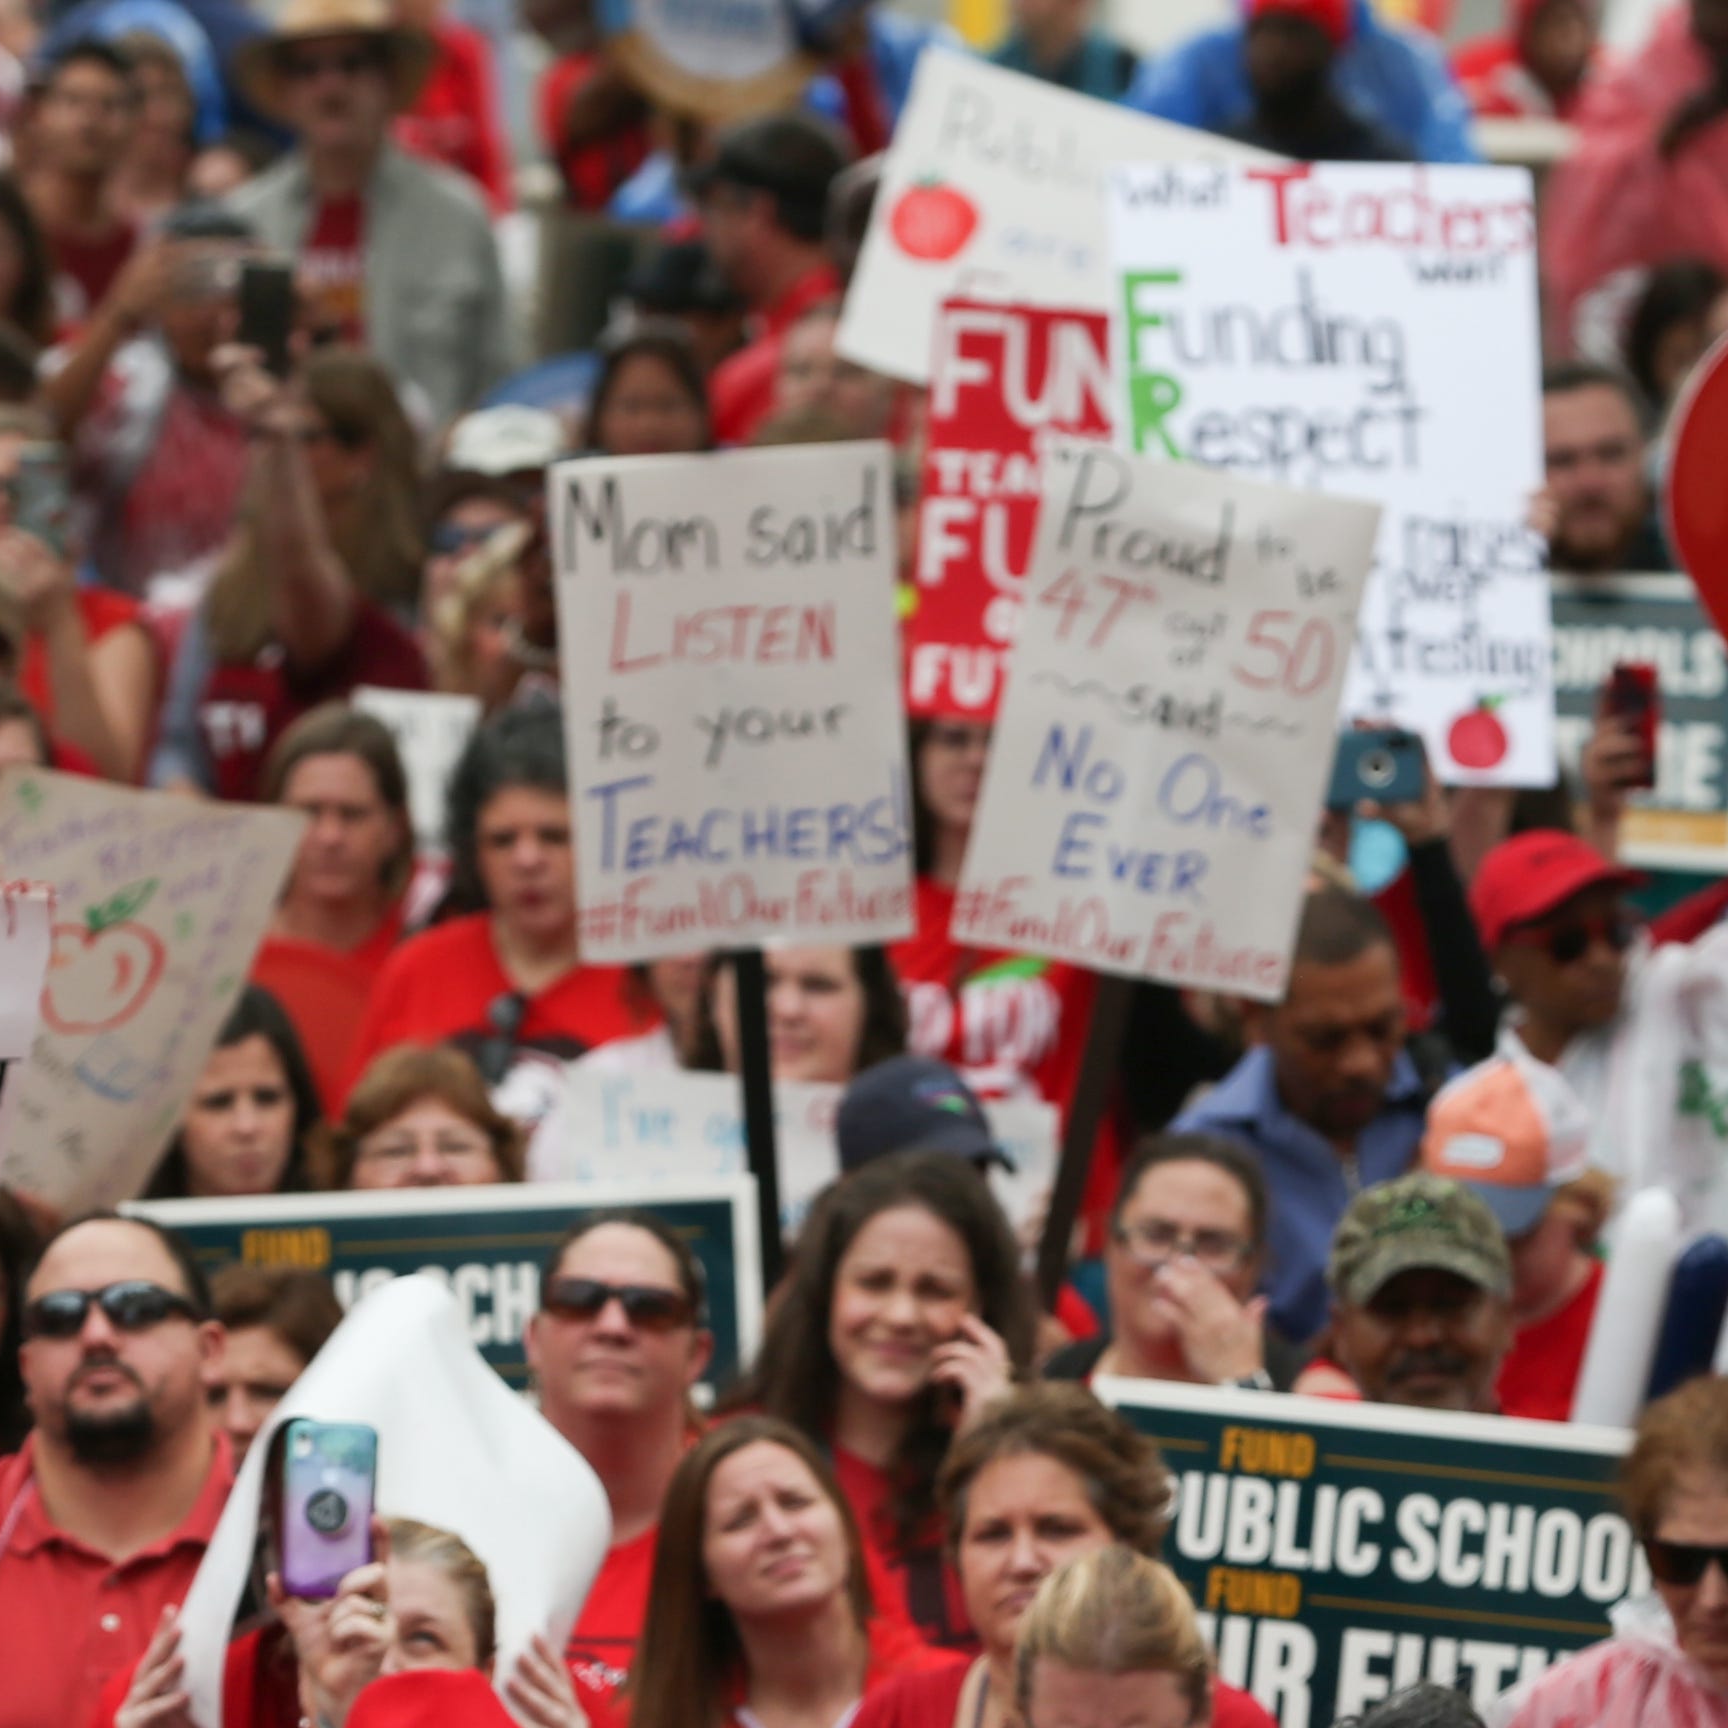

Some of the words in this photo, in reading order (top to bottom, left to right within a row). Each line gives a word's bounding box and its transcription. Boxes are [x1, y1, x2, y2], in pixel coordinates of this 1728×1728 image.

[1242, 161, 1536, 252] Teachers
[1122, 266, 1410, 400] Funding
[1128, 372, 1434, 490] Respect
[562, 482, 720, 576] Mom
[745, 464, 880, 572] said
[610, 590, 836, 674] LISTEN
[596, 700, 661, 762] to
[694, 703, 849, 770] your
[1030, 724, 1128, 804] No
[1156, 750, 1272, 843] One
[1052, 810, 1210, 896] EVER
[242, 1227, 331, 1265] FUND
[1221, 1424, 1316, 1478] FUND
[1205, 1566, 1302, 1616] FUND
